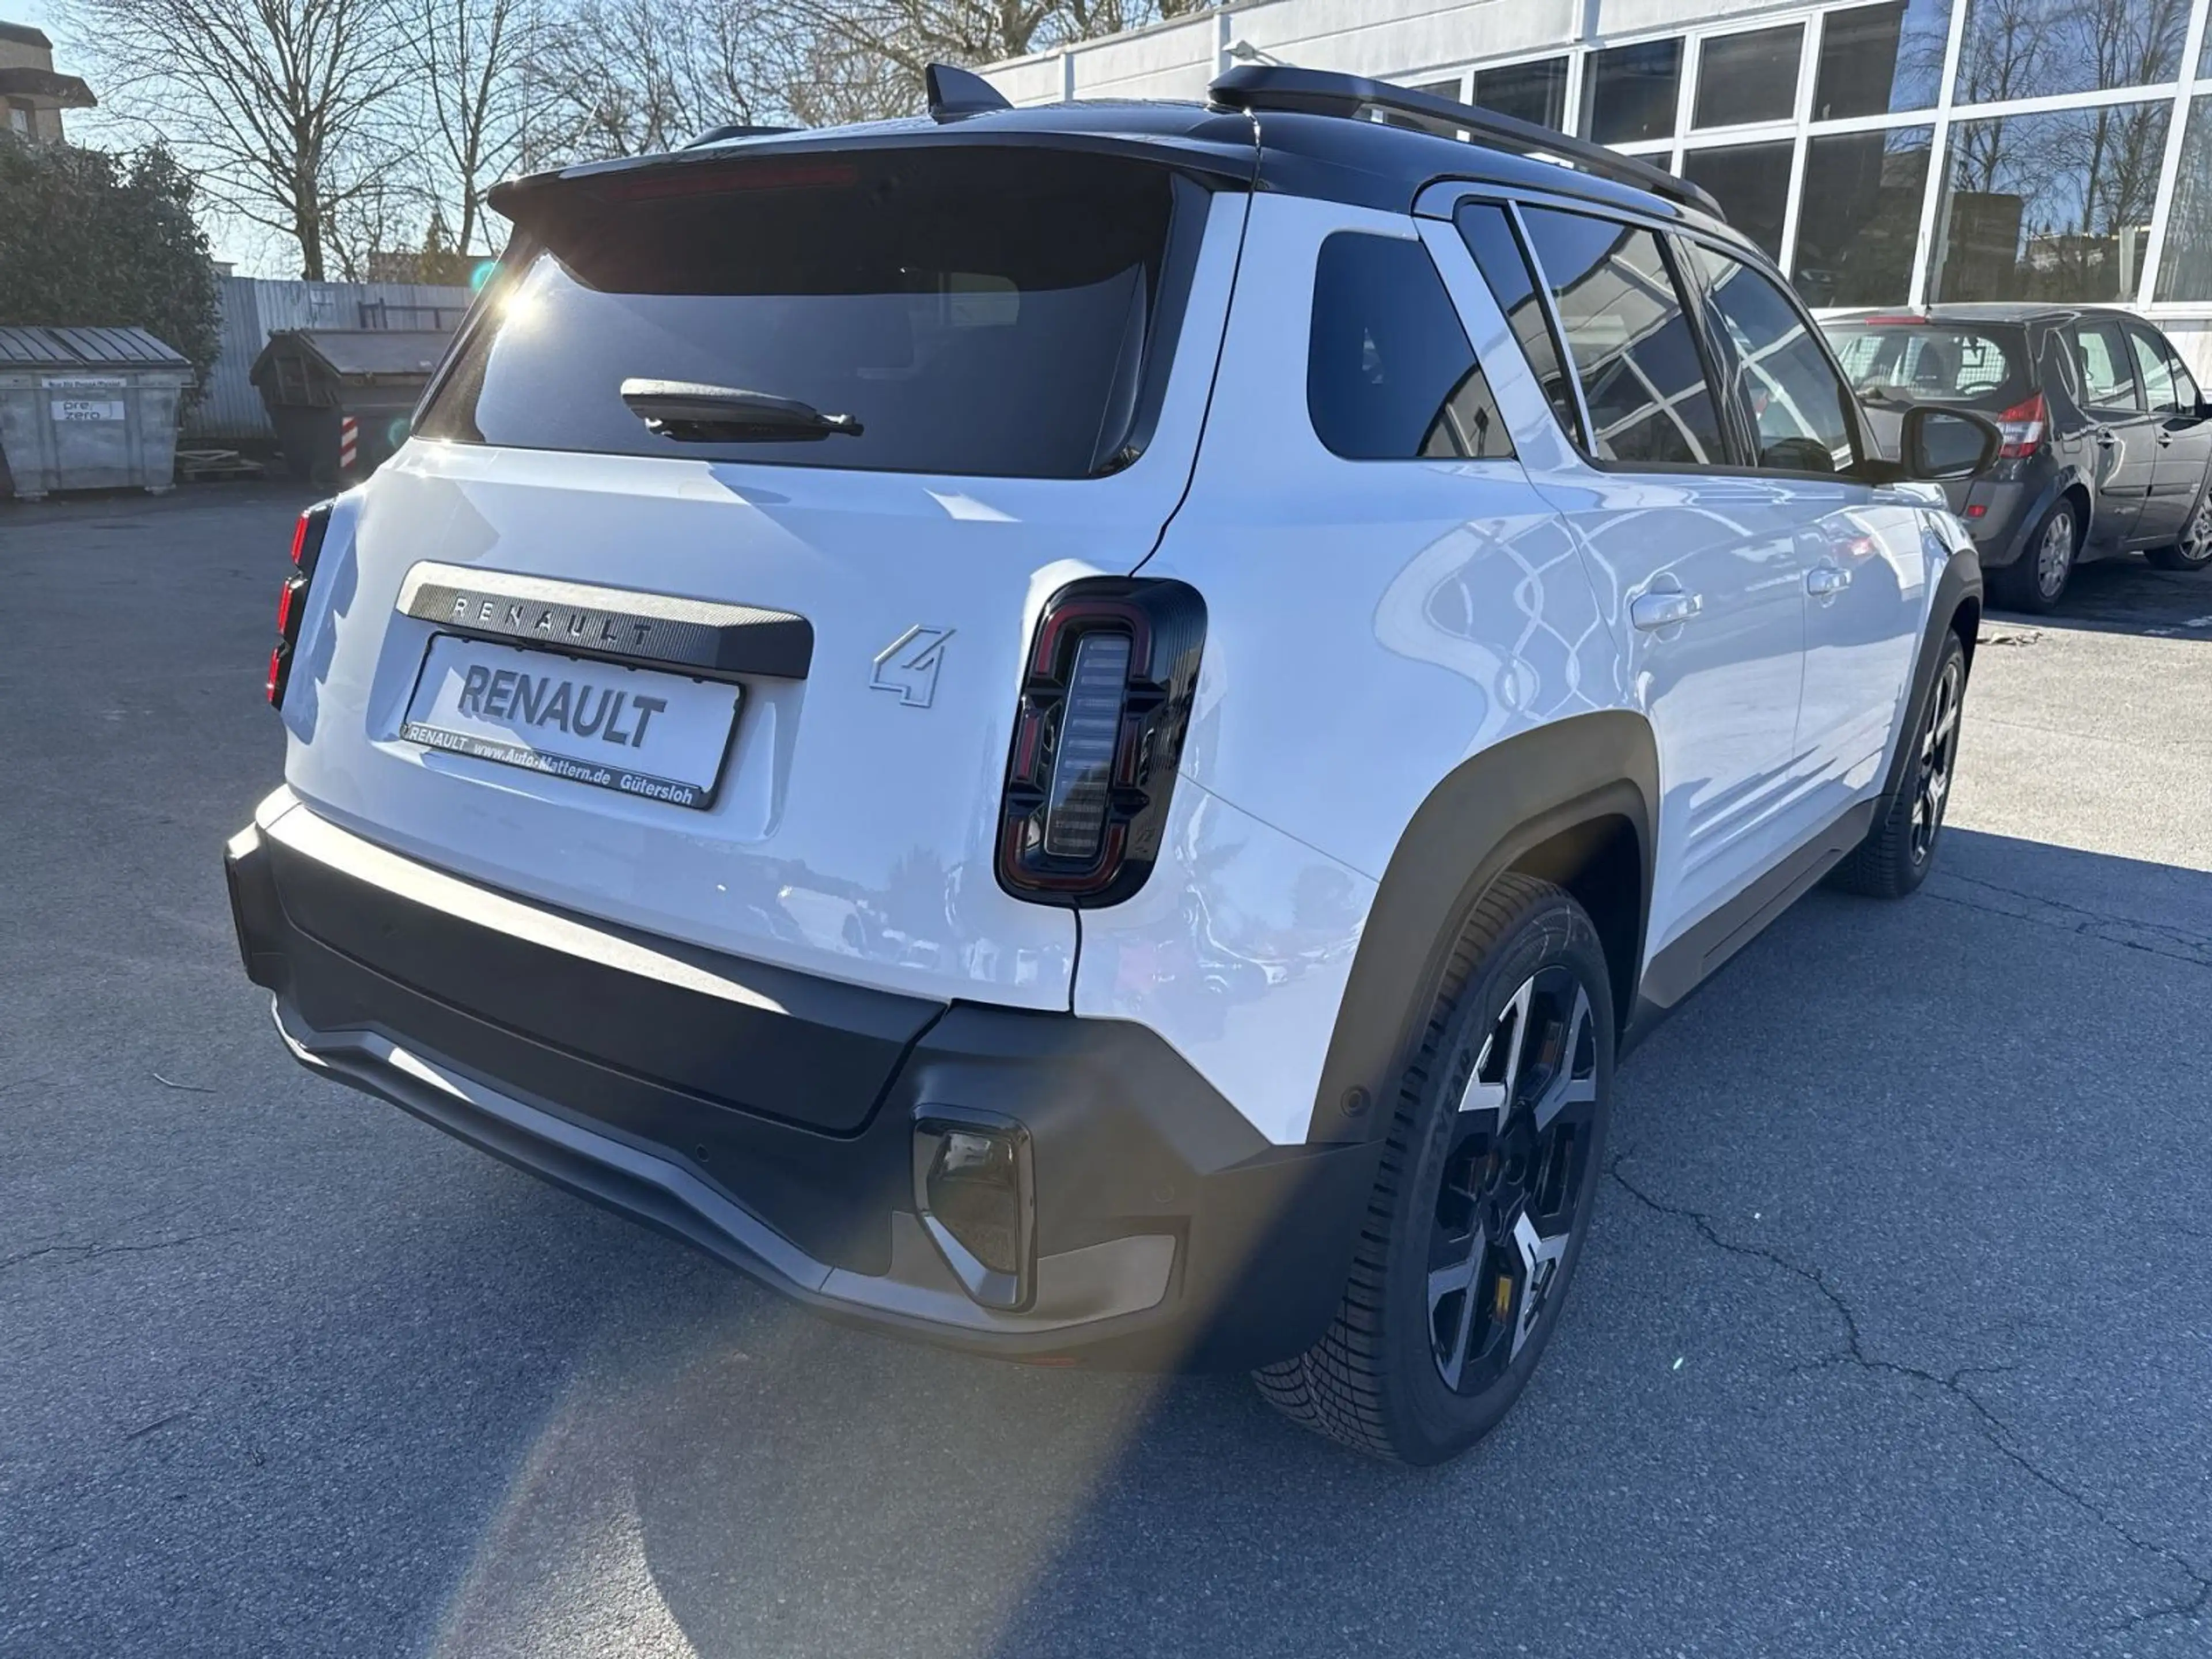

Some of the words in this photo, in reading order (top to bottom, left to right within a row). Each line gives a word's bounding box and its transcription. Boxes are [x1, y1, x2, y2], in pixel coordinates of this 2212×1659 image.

[63, 401, 89, 410] pre
[65, 411, 100, 421] zero
[452, 597, 652, 645] RENAULT
[869, 624, 957, 709] 4
[457, 664, 668, 748] RENAULT
[409, 726, 469, 750] RENAULT
[620, 774, 693, 805] Gütersloh
